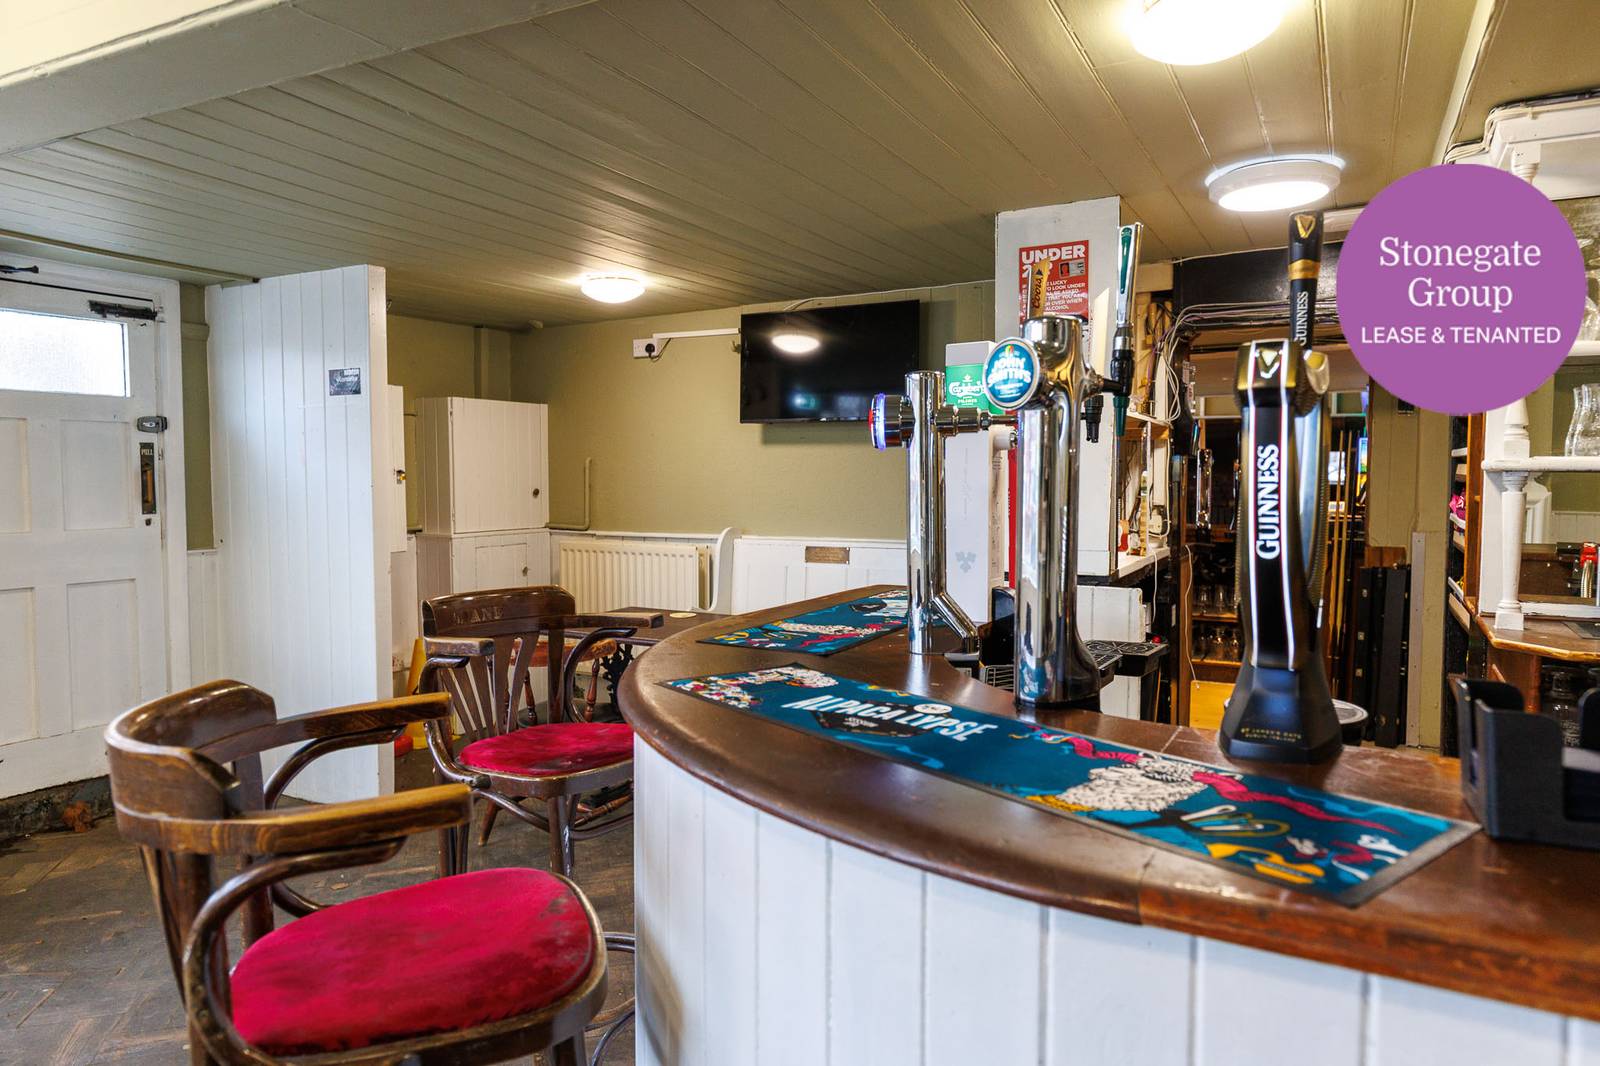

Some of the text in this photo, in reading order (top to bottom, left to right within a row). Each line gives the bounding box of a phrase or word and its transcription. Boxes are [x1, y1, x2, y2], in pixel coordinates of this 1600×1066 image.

[1022, 244, 1085, 264] UNDER
[1293, 291, 1309, 347] GUINNESS
[1255, 443, 1281, 560] GUINNESS
